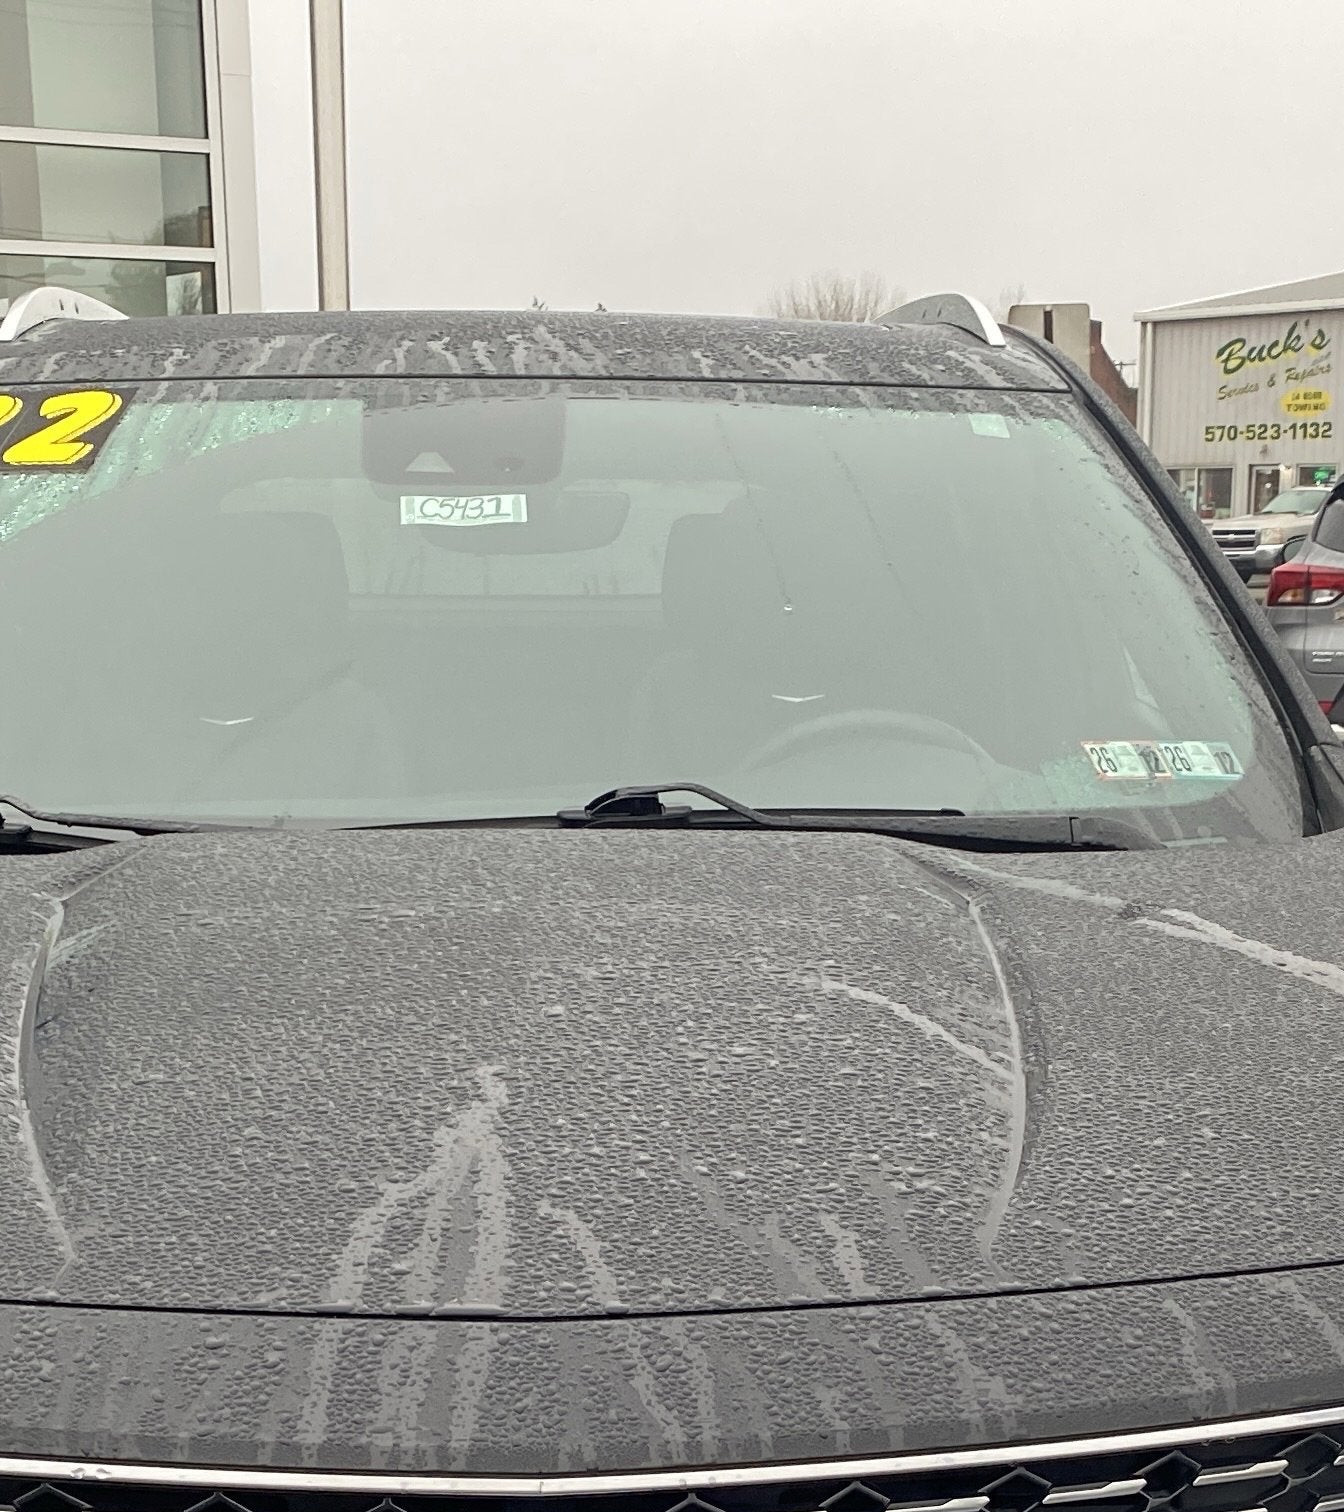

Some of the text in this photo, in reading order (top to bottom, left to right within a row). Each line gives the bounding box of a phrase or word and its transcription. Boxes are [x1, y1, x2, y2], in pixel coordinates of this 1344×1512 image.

[1204, 421, 1332, 442] 570-523-1132
[1089, 746, 1118, 773] 26
[1164, 745, 1192, 772] 26
